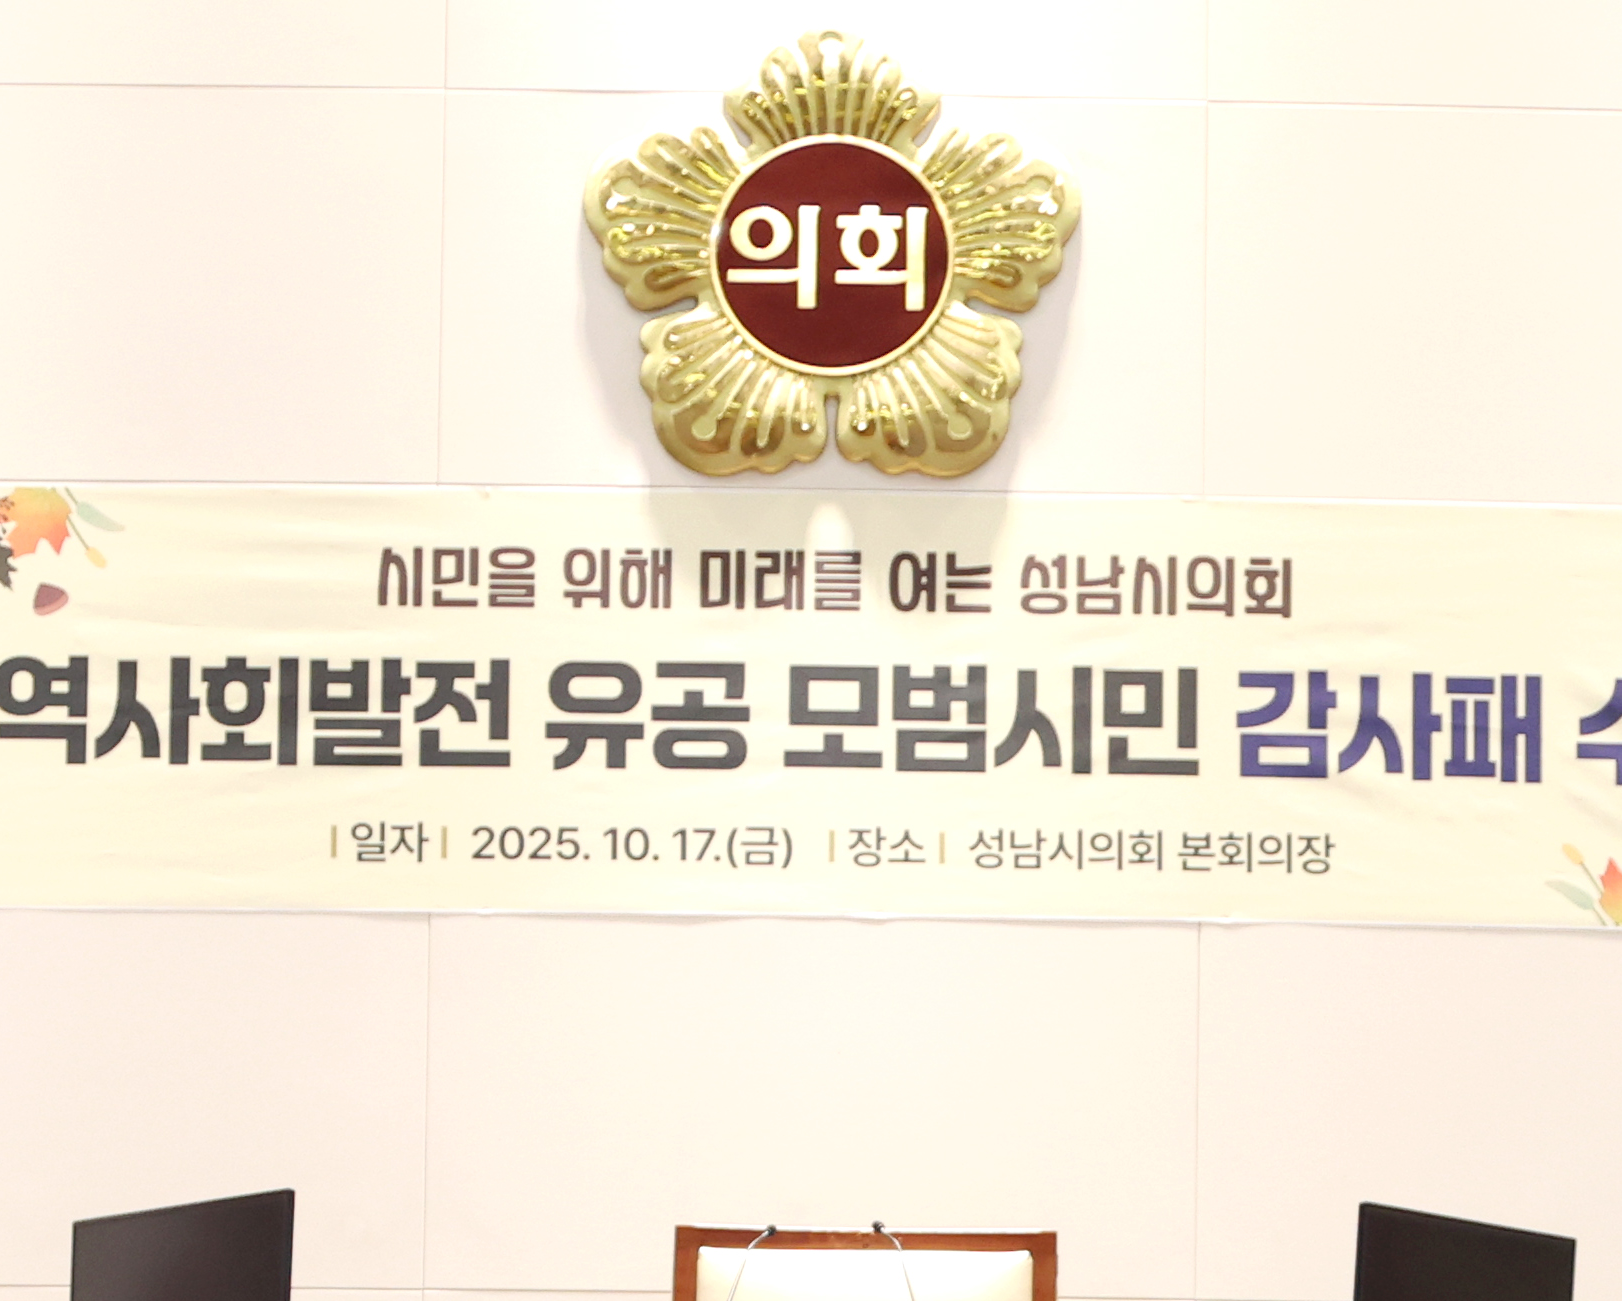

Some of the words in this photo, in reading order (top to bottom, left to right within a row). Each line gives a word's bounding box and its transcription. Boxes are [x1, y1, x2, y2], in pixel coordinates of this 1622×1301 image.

[726, 205, 929, 312] 의회
[378, 547, 535, 608] 시민을
[564, 549, 673, 609] 위해
[699, 549, 862, 611] 미래를
[889, 552, 992, 613] 여는
[1021, 555, 1291, 619] 성남시의회
[546, 661, 750, 770] 유공
[784, 665, 1199, 776] 모범시민
[1237, 670, 1541, 783] 감사패
[351, 822, 429, 862] 일자
[471, 826, 591, 860] 2025.
[603, 828, 661, 861] 10.
[672, 828, 794, 868] 17.(금)
[850, 828, 925, 866] 장소
[970, 830, 1164, 871] 성남시의회
[1178, 833, 1335, 874] 본회의장
